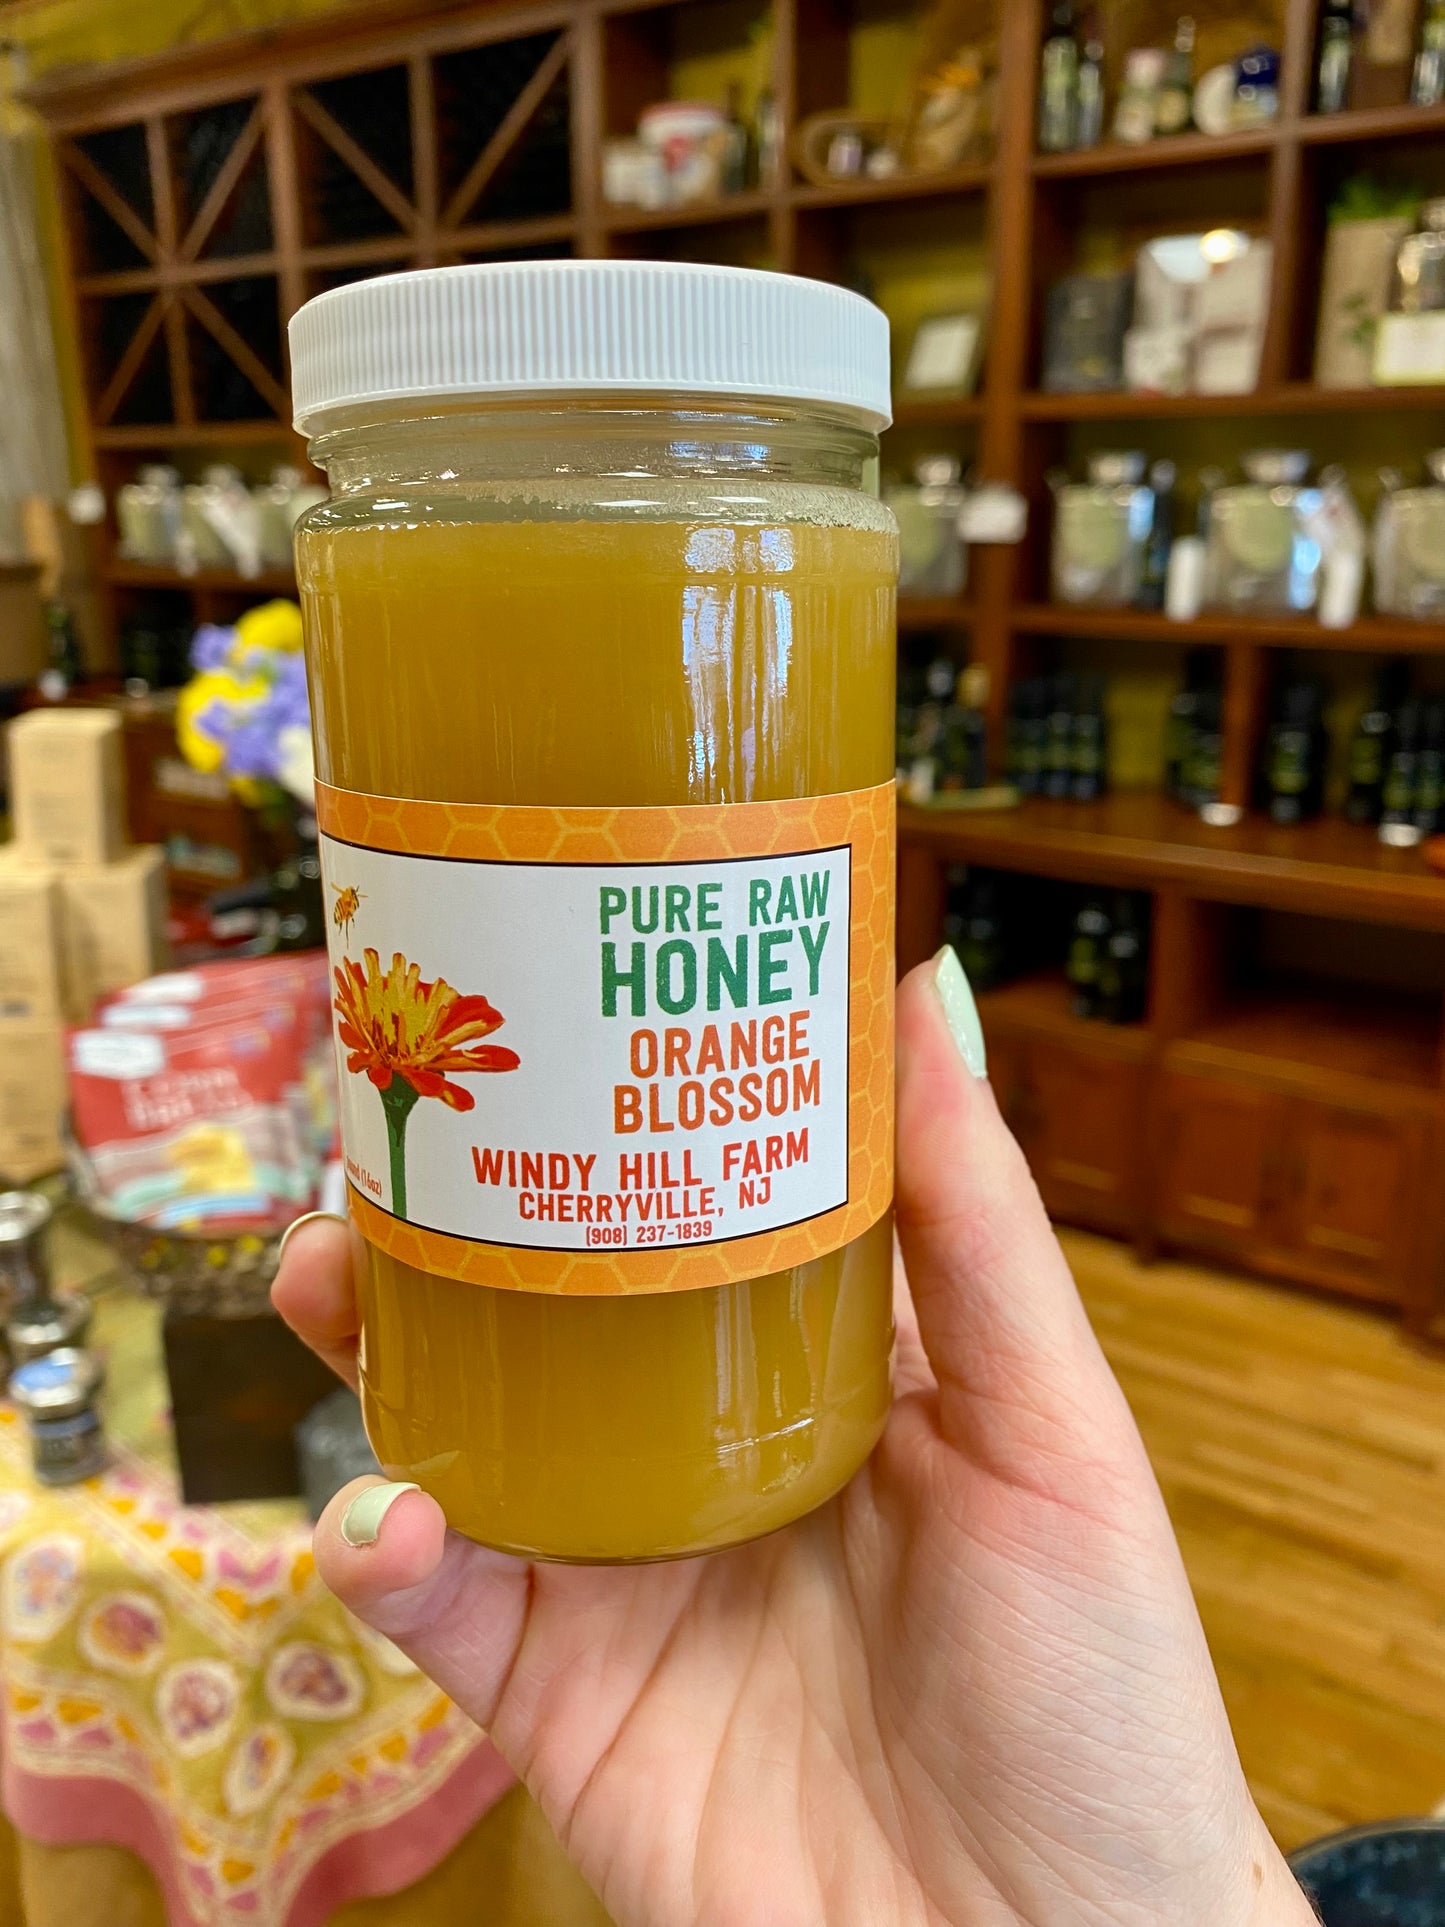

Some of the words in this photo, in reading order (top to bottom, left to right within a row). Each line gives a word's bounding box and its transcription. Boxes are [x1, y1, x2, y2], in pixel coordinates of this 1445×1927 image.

[600, 883, 723, 935] PURE
[749, 870, 830, 927] RAW
[601, 921, 830, 1018] HONEY
[629, 1010, 811, 1079] ORANGE
[613, 1059, 821, 1135] BLOSSOM
[471, 1146, 597, 1192] WINDY
[619, 1149, 703, 1191] HILL
[722, 1127, 809, 1181] FARM
[518, 1186, 724, 1223] CHERRYVILLE,
[739, 1176, 771, 1209] NJ
[586, 1225, 627, 1246] (908)
[636, 1220, 713, 1244] 237-1839
